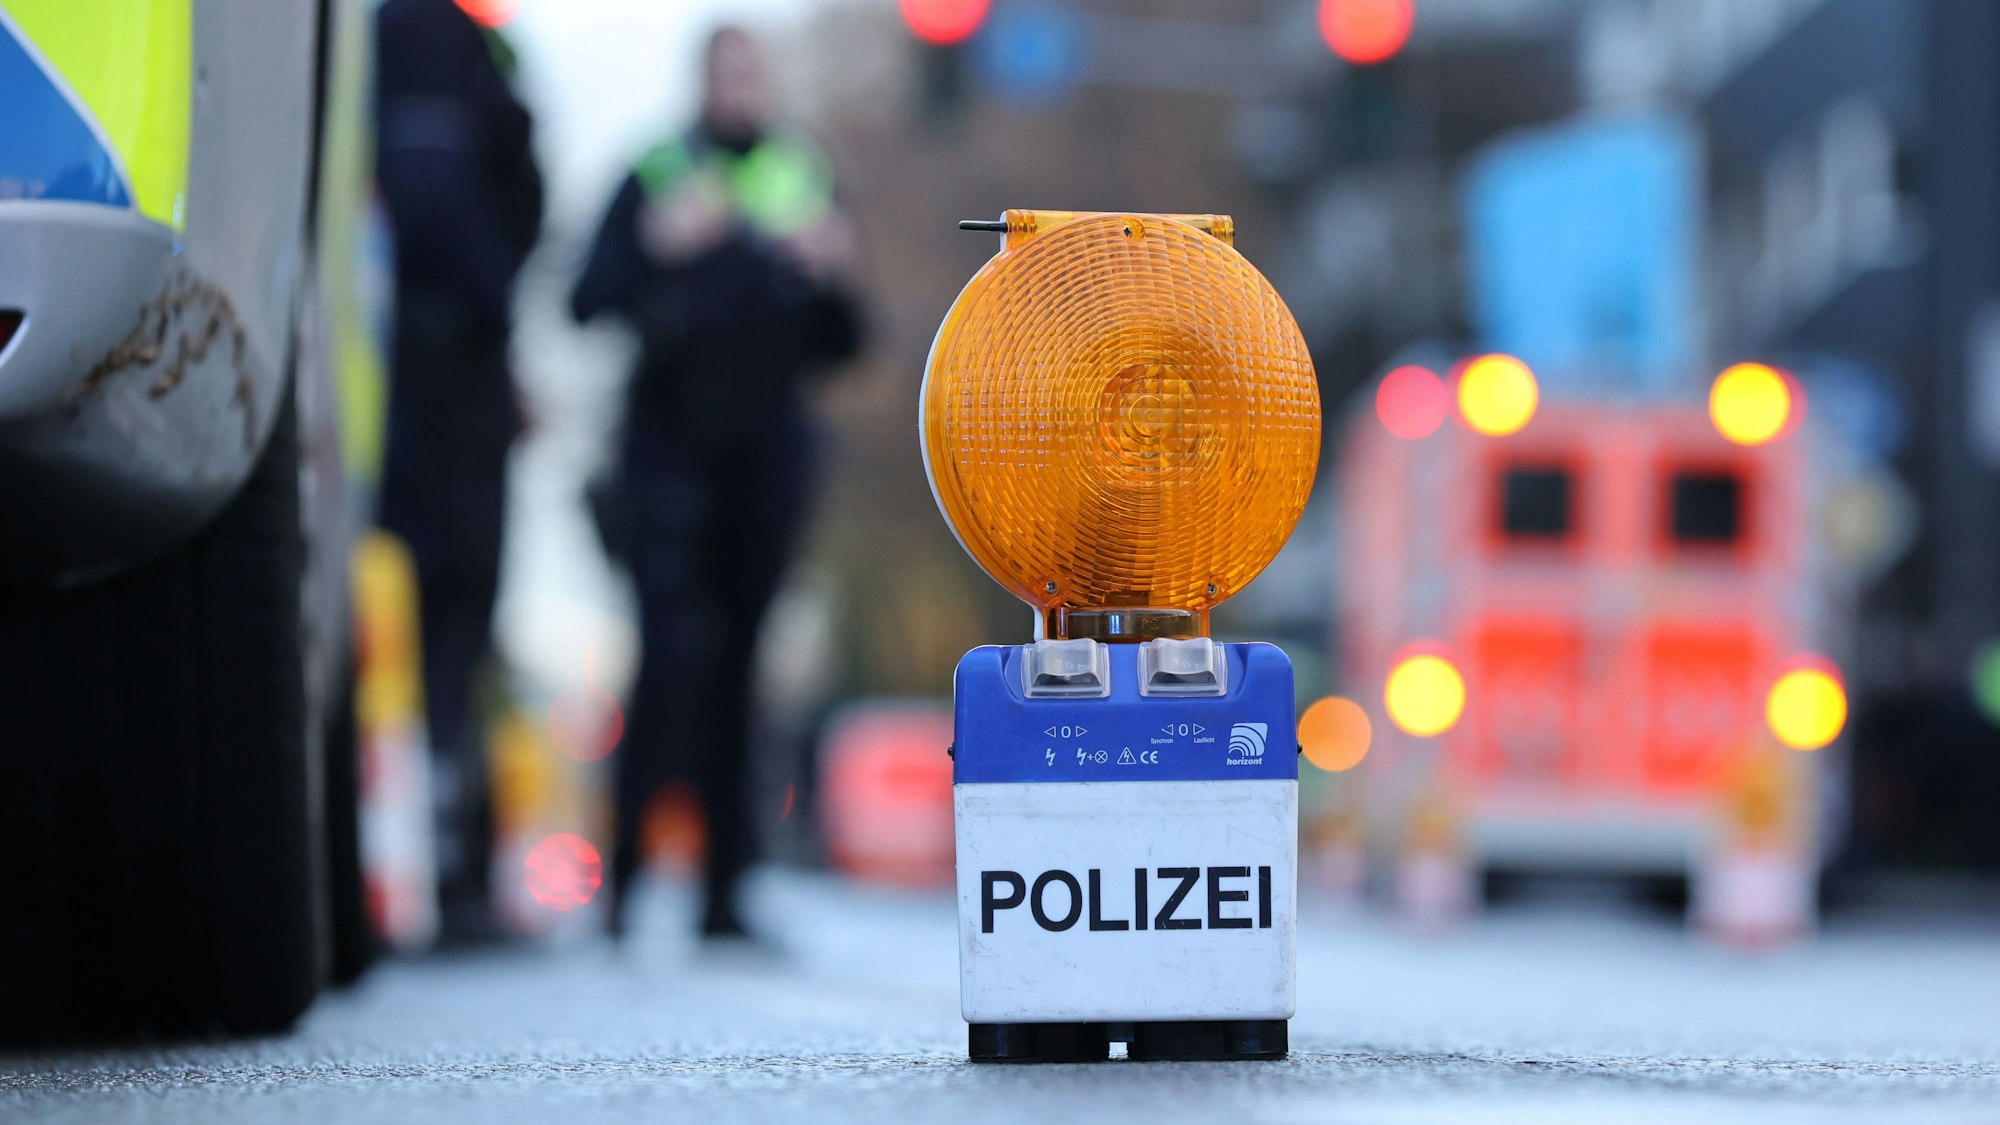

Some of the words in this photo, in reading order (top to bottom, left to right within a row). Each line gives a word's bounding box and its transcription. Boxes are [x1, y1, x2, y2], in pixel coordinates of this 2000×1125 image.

[1150, 737, 1174, 745] Synchron
[1226, 757, 1263, 765] horizont
[981, 866, 1272, 933] POLIZEI
